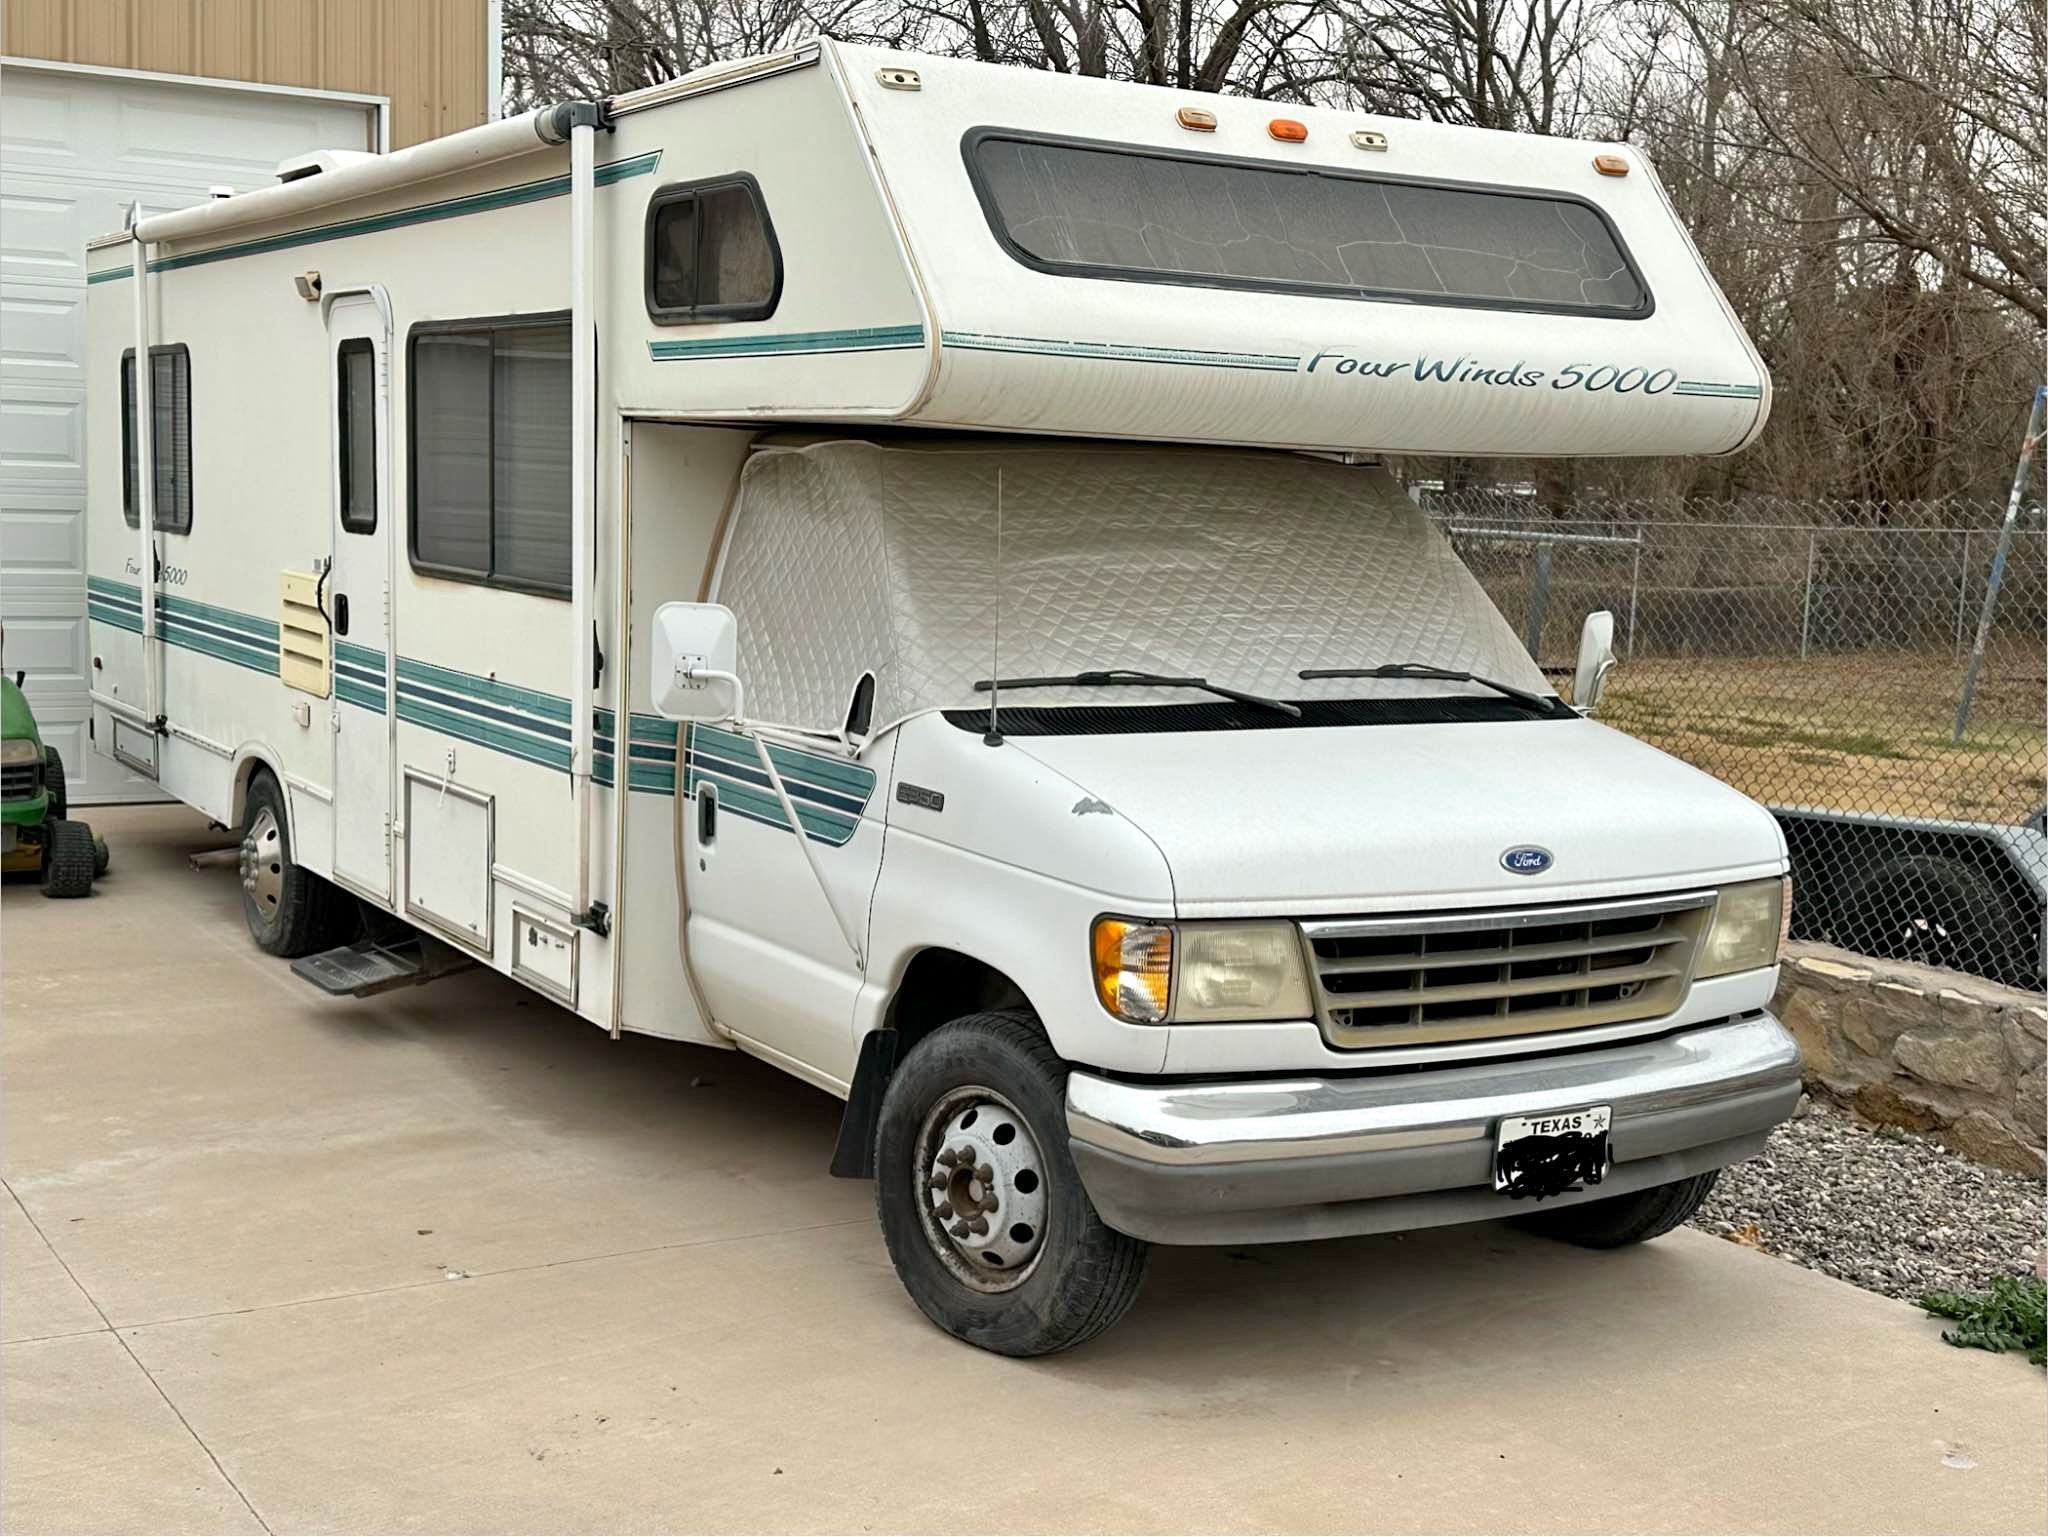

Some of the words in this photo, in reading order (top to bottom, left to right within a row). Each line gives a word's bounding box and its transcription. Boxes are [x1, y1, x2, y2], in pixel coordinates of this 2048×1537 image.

[1306, 345, 1411, 377] Four
[1413, 352, 1544, 387] Winds
[1551, 363, 1678, 394] 5000
[125, 557, 142, 575] Four
[163, 565, 188, 585] 5000
[1514, 852, 1542, 867] Ford
[1531, 1116, 1582, 1135] TEXAS
